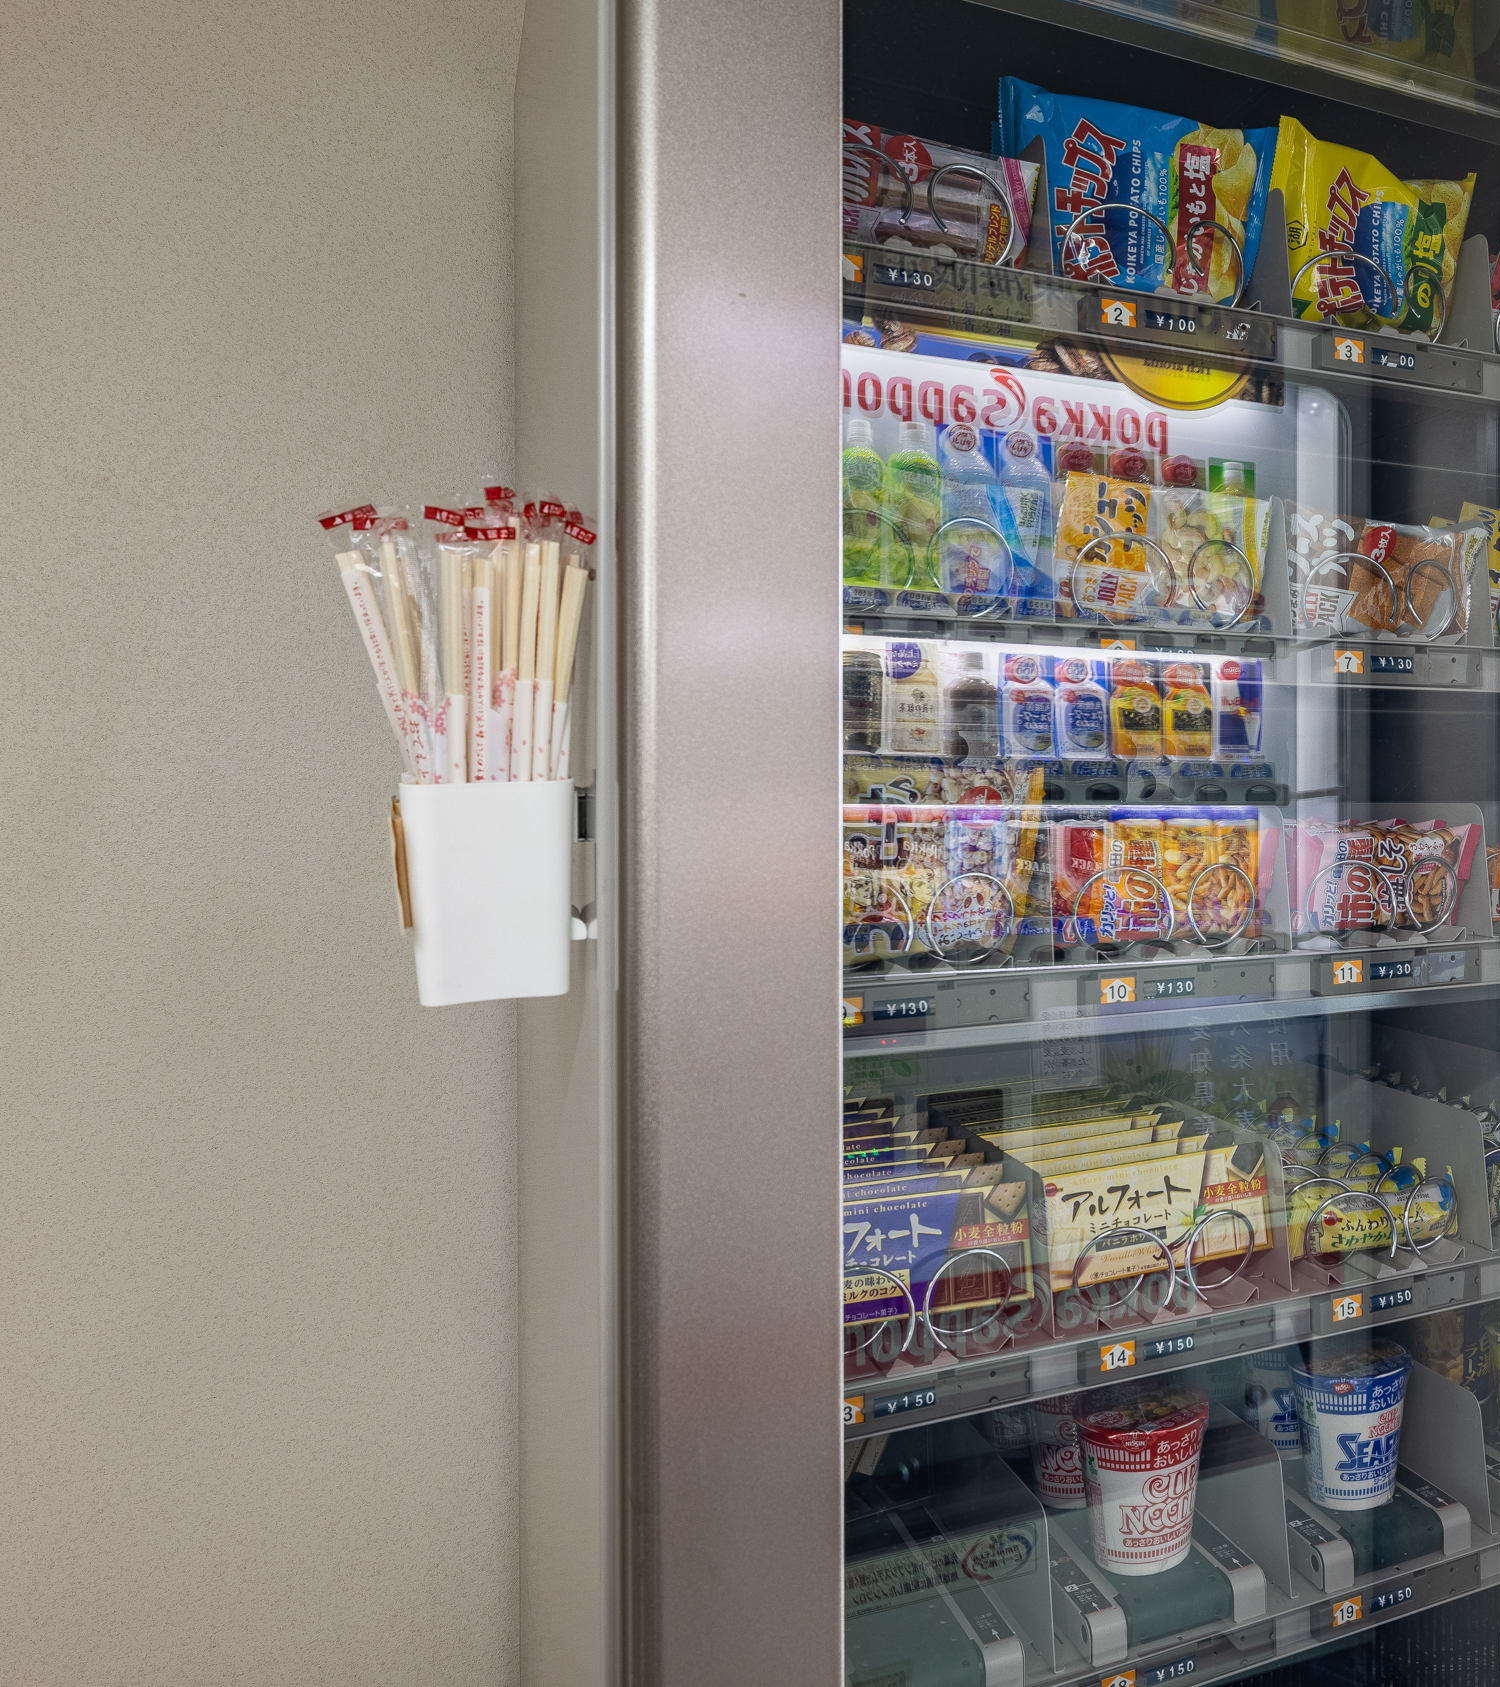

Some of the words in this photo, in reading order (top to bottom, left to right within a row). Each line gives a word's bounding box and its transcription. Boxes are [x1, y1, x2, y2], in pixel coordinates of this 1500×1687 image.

[1131, 139, 1142, 175] CHIPS
[1371, 190, 1385, 226] CHIPS
[1126, 230, 1138, 284] KOIKEYA
[888, 267, 933, 287] ¥130
[1413, 231, 1443, 308] のり塩
[1113, 306, 1124, 322] 2
[1156, 313, 1196, 333] ¥100
[1344, 345, 1353, 359] 3
[1380, 353, 1415, 369] ¥00
[1097, 571, 1120, 607] JOLLY
[1116, 576, 1139, 608] PACK
[1344, 655, 1352, 670] 7
[1379, 656, 1413, 670] ¥130
[1099, 883, 1116, 941] カリッと!
[1321, 880, 1338, 929] カリッと!
[1340, 967, 1354, 981] 11
[1108, 984, 1127, 1000] 10
[1156, 980, 1194, 994] ¥130
[887, 1000, 929, 1017] ¥130
[1071, 1175, 1106, 1187] Alfort
[1106, 1170, 1129, 1181] mini
[1130, 1163, 1179, 1177] chocolate
[855, 1183, 907, 1198] chocolate
[1203, 1178, 1262, 1200] 小麦全粒粉
[873, 1199, 928, 1214] chocolate
[1061, 1175, 1192, 1223] アルフォート
[954, 1221, 1024, 1241] 小麦全粒粉
[1379, 1290, 1412, 1308] ¥150
[1340, 1303, 1355, 1317] 15
[1155, 1336, 1195, 1354] ¥150
[1106, 1349, 1127, 1366] 14
[887, 1391, 935, 1413] ¥150
[1377, 1407, 1399, 1425] CUP
[1125, 1439, 1146, 1447] NISSIN
[1156, 1429, 1198, 1455] あっさり
[1142, 1458, 1200, 1504] CUP
[1378, 1588, 1413, 1607] ¥150
[1339, 1604, 1354, 1621] 19
[1156, 1660, 1194, 1681] ¥150
